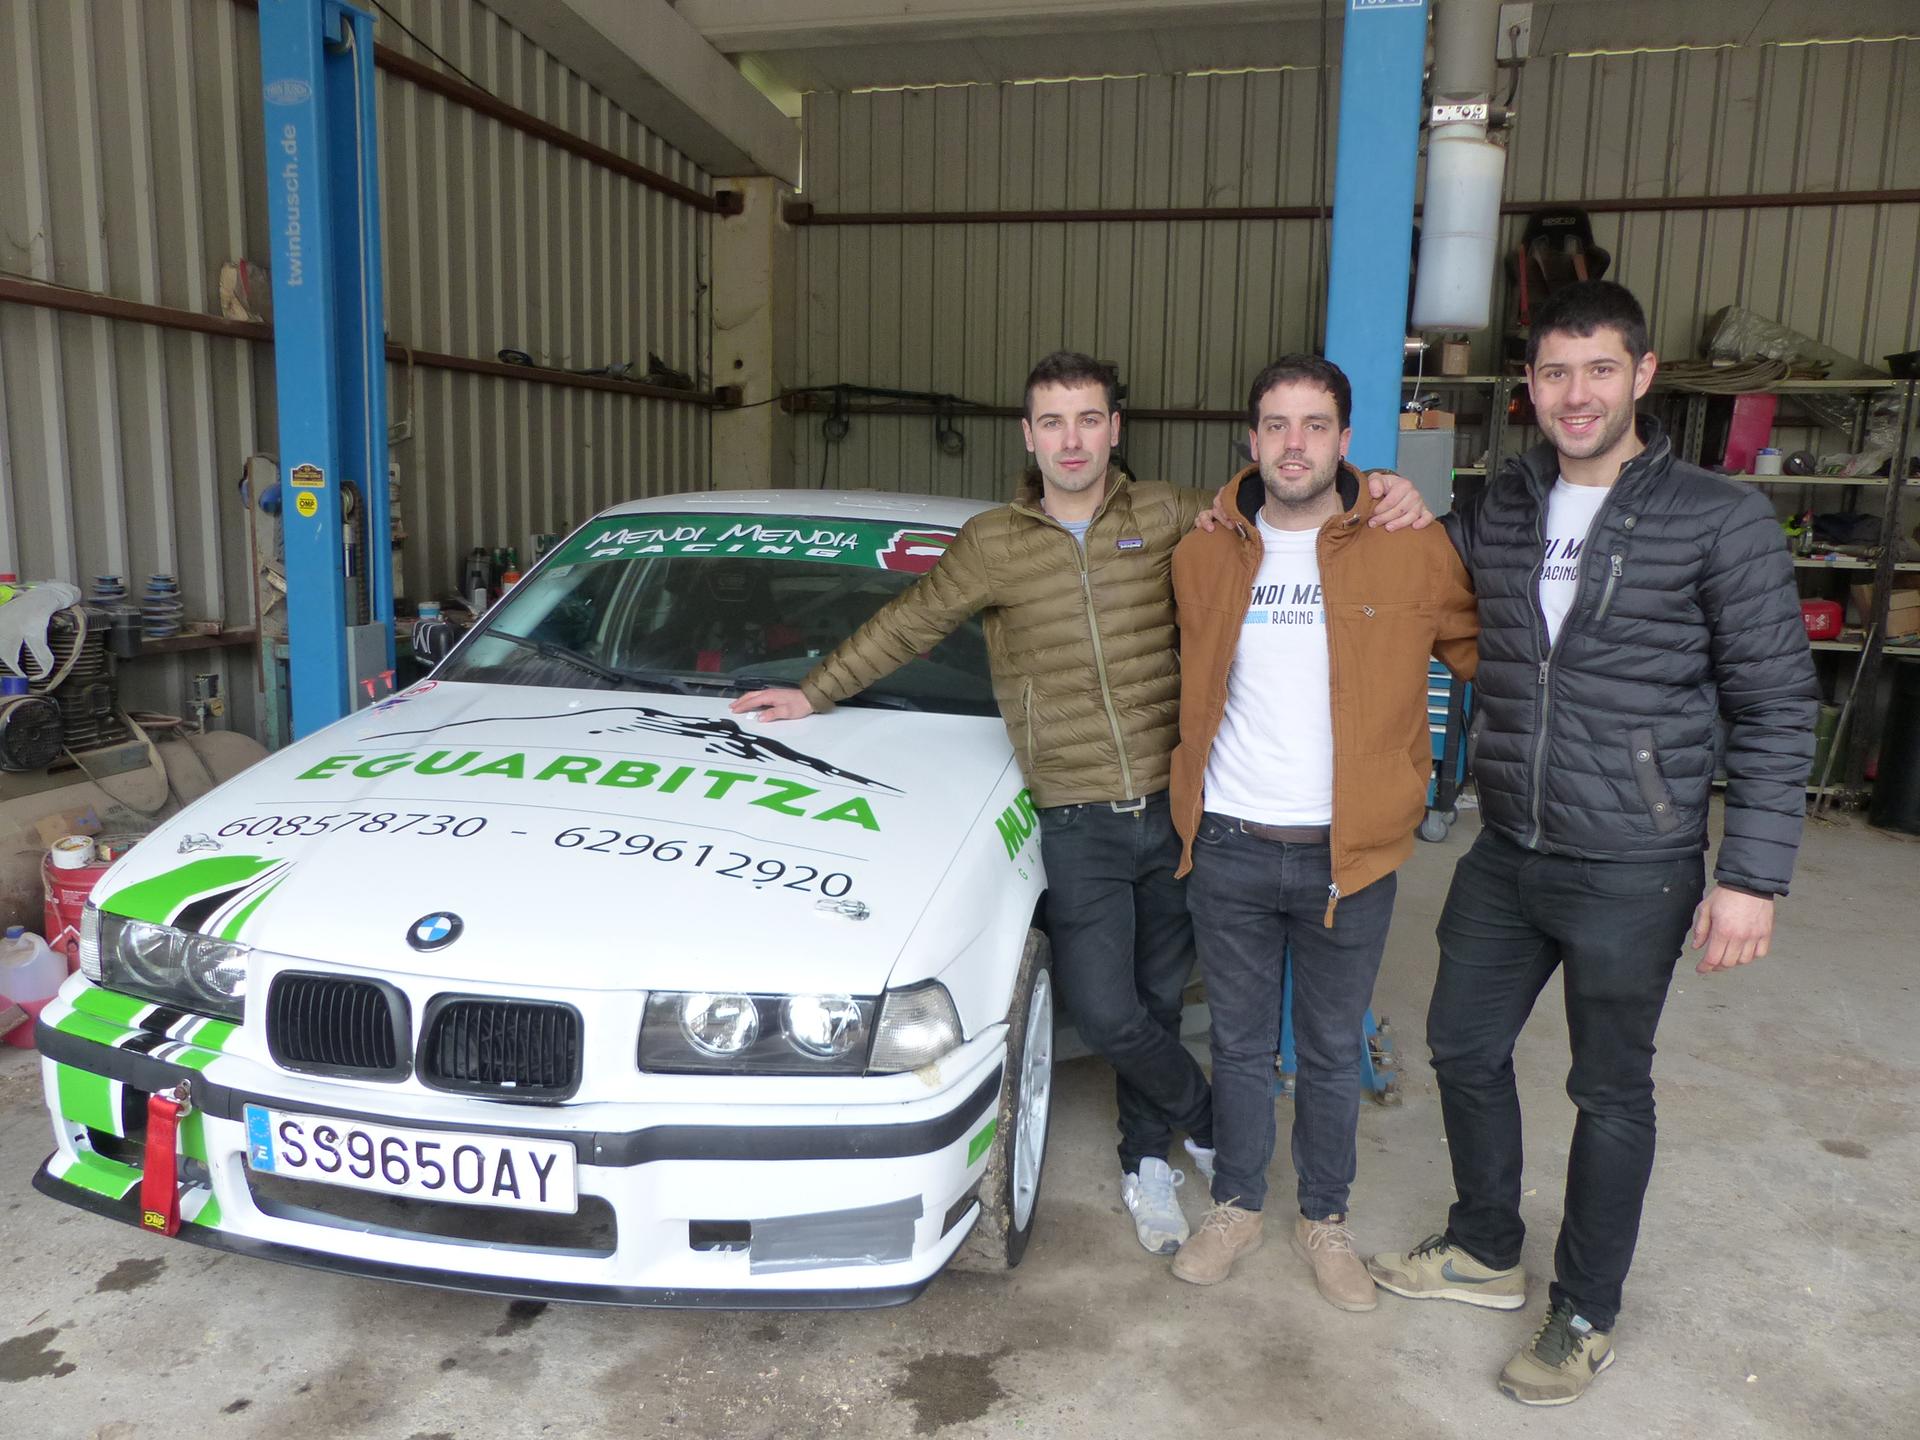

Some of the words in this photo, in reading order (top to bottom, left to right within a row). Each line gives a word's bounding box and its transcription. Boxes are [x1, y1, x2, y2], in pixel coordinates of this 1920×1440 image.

[281, 123, 304, 288] twinbusch.de
[586, 527, 705, 550] MENDI
[716, 523, 860, 551] MENDIA
[589, 543, 842, 559] RACING
[1250, 584, 1286, 606] NDI
[1272, 610, 1314, 625] RACING
[295, 750, 882, 832] EGUARBITZA
[217, 811, 488, 838] 608578730
[554, 826, 853, 898] 629612920
[278, 1119, 558, 1203] SS9650AY
